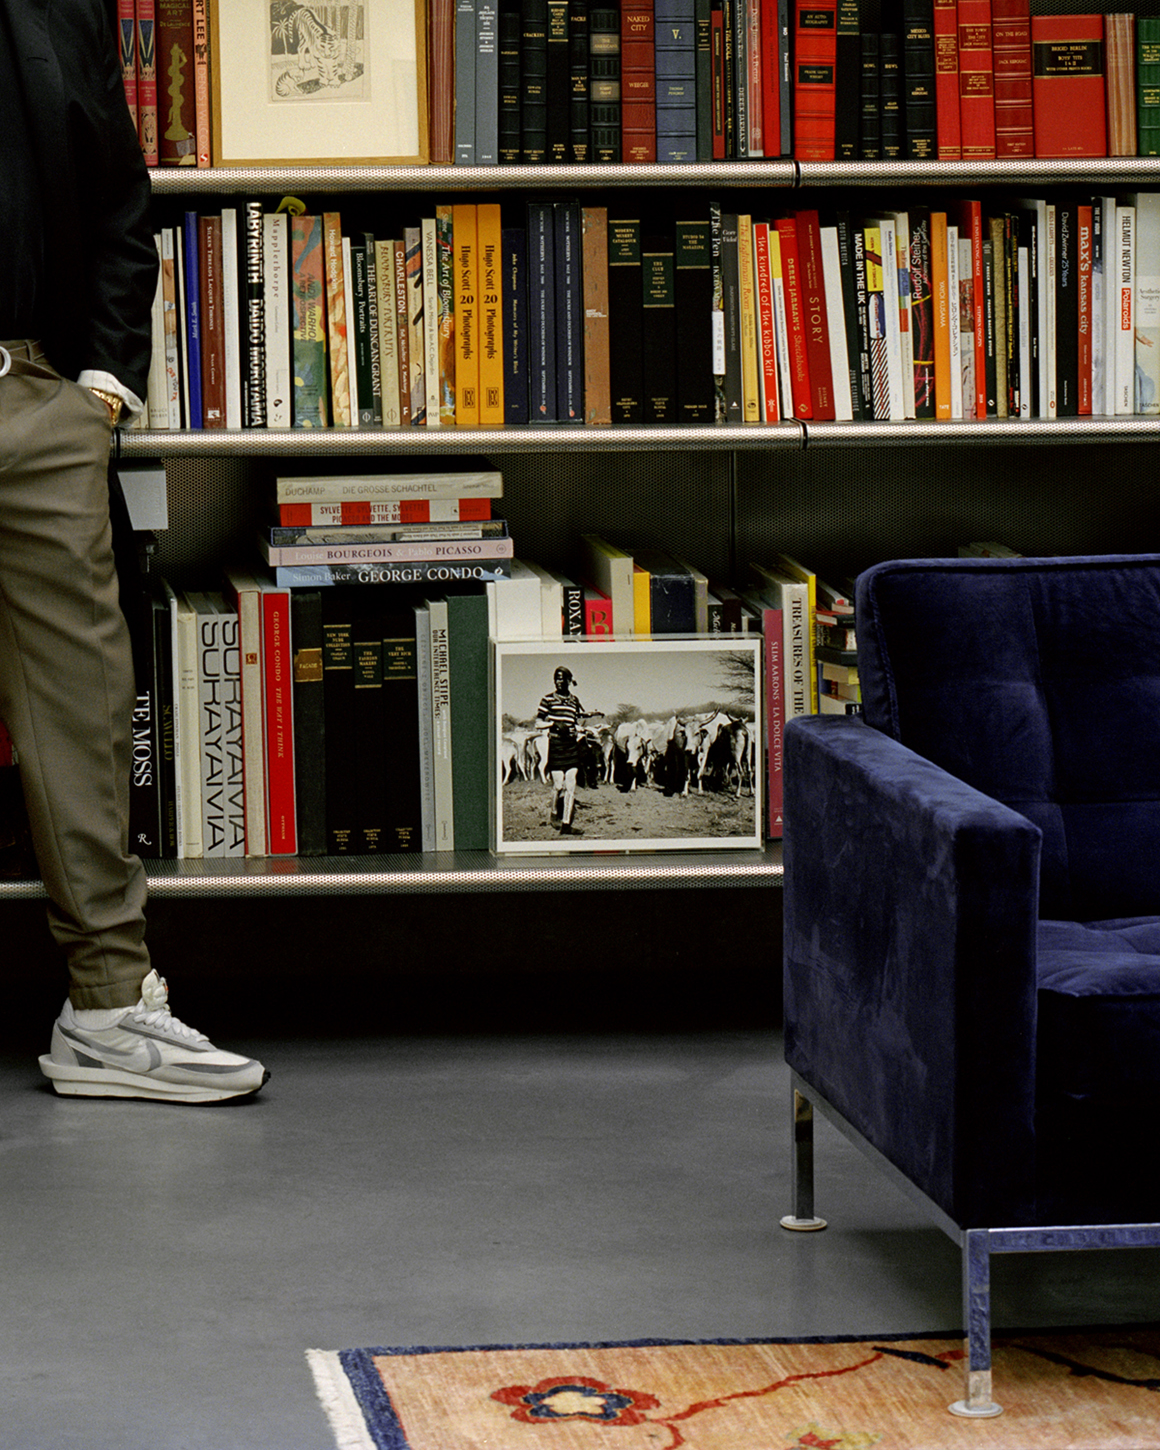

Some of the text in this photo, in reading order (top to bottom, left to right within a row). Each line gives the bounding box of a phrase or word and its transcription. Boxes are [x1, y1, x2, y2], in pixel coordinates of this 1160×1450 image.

[196, 19, 205, 39] LEE
[1080, 226, 1090, 272] max's
[1122, 216, 1131, 247] HELMUT
[395, 251, 405, 313] CHARLESTON
[1122, 249, 1131, 283] NEWTON
[247, 202, 265, 426] LABYRINTH DAIDO MORIYAMA
[483, 245, 498, 360] Hugo Scott 20 Photographs
[1079, 315, 1088, 335] city
[327, 546, 482, 559] BOURGEOIS PICASSO
[358, 566, 484, 583] GEORGE CONDO
[438, 629, 449, 706] MICHAEL STIPE
[792, 598, 804, 714] TREASURES OF THE
[132, 727, 152, 787] MOSS
